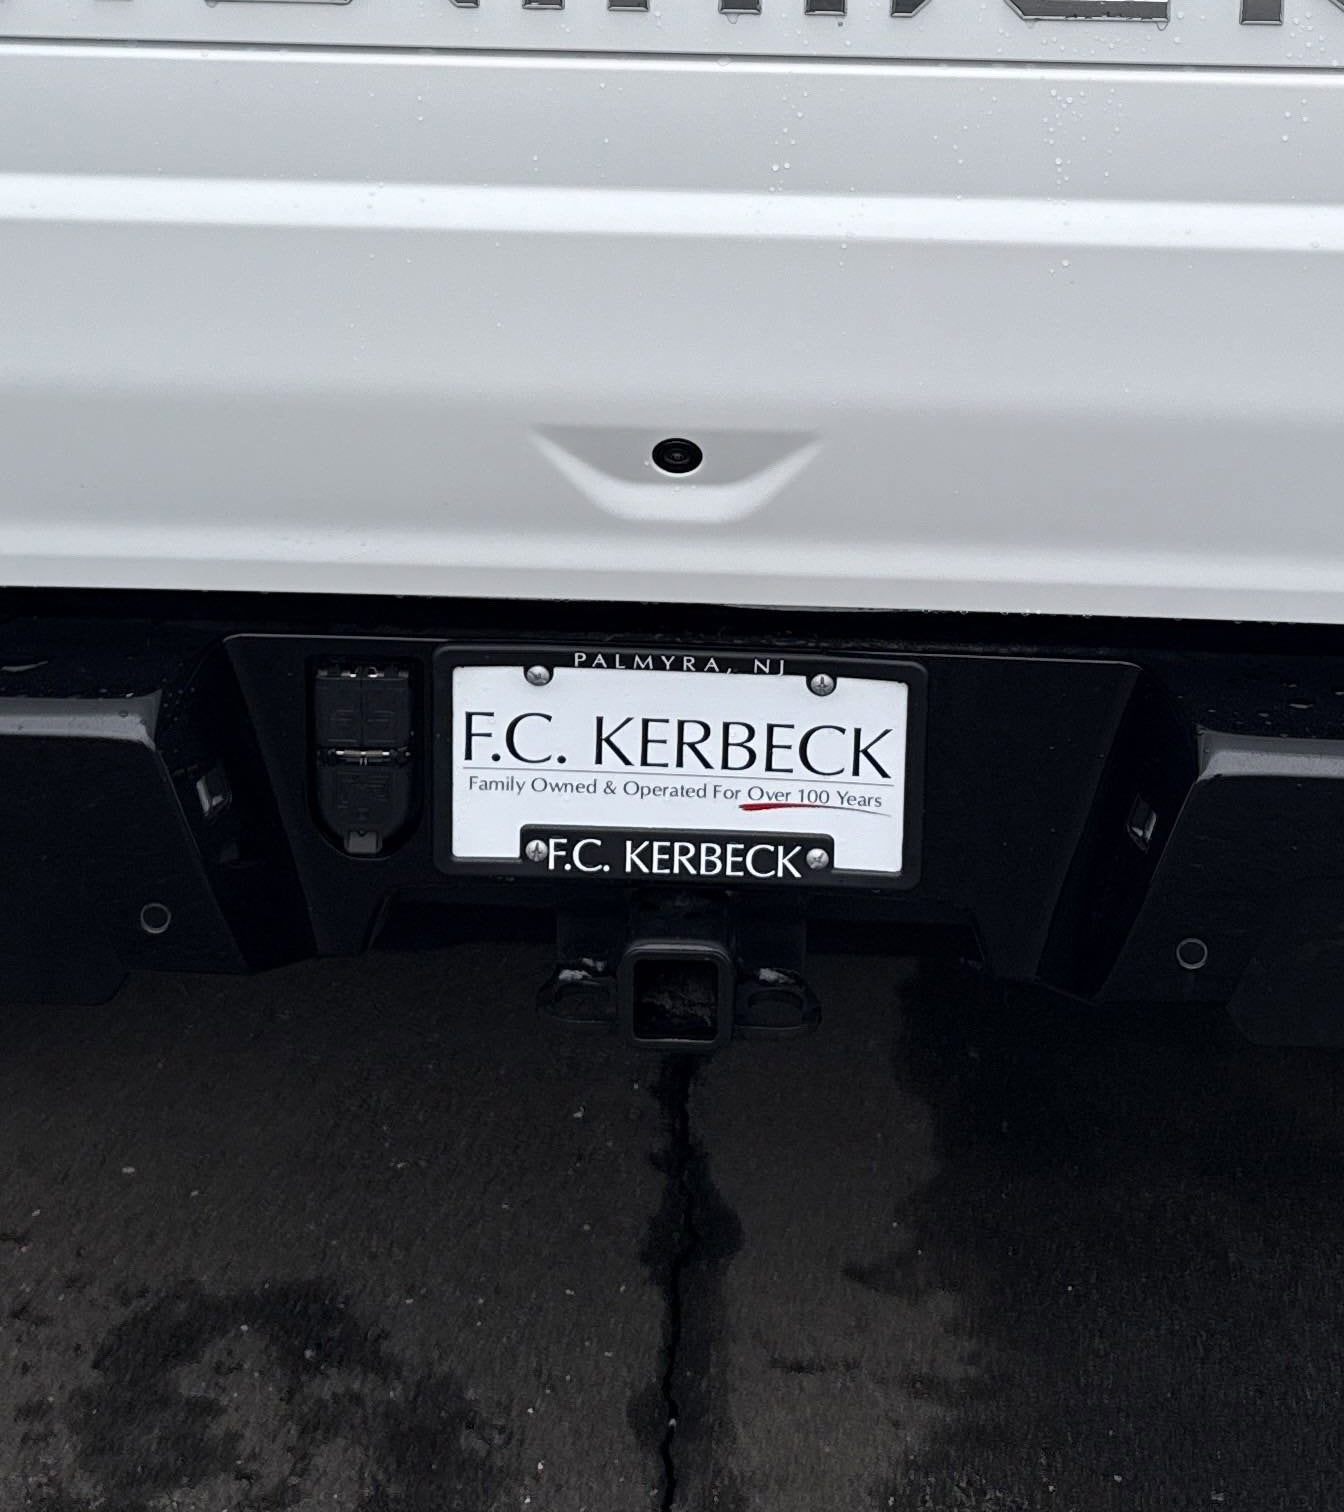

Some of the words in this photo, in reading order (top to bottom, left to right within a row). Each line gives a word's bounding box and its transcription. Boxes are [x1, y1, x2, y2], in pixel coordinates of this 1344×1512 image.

[573, 651, 732, 675] PALMYRA,
[754, 657, 786, 677] NJ
[463, 710, 568, 765] F.C.
[593, 715, 893, 780] KERBECK
[468, 774, 525, 796] Family
[530, 777, 597, 795] Owned
[603, 779, 617, 796] &
[622, 780, 708, 800] Operated
[713, 784, 741, 801] For
[747, 786, 791, 803] Over
[798, 788, 830, 804] 100
[836, 789, 882, 808] Years
[547, 837, 611, 873] F.C.
[624, 839, 803, 879] KERBECK
